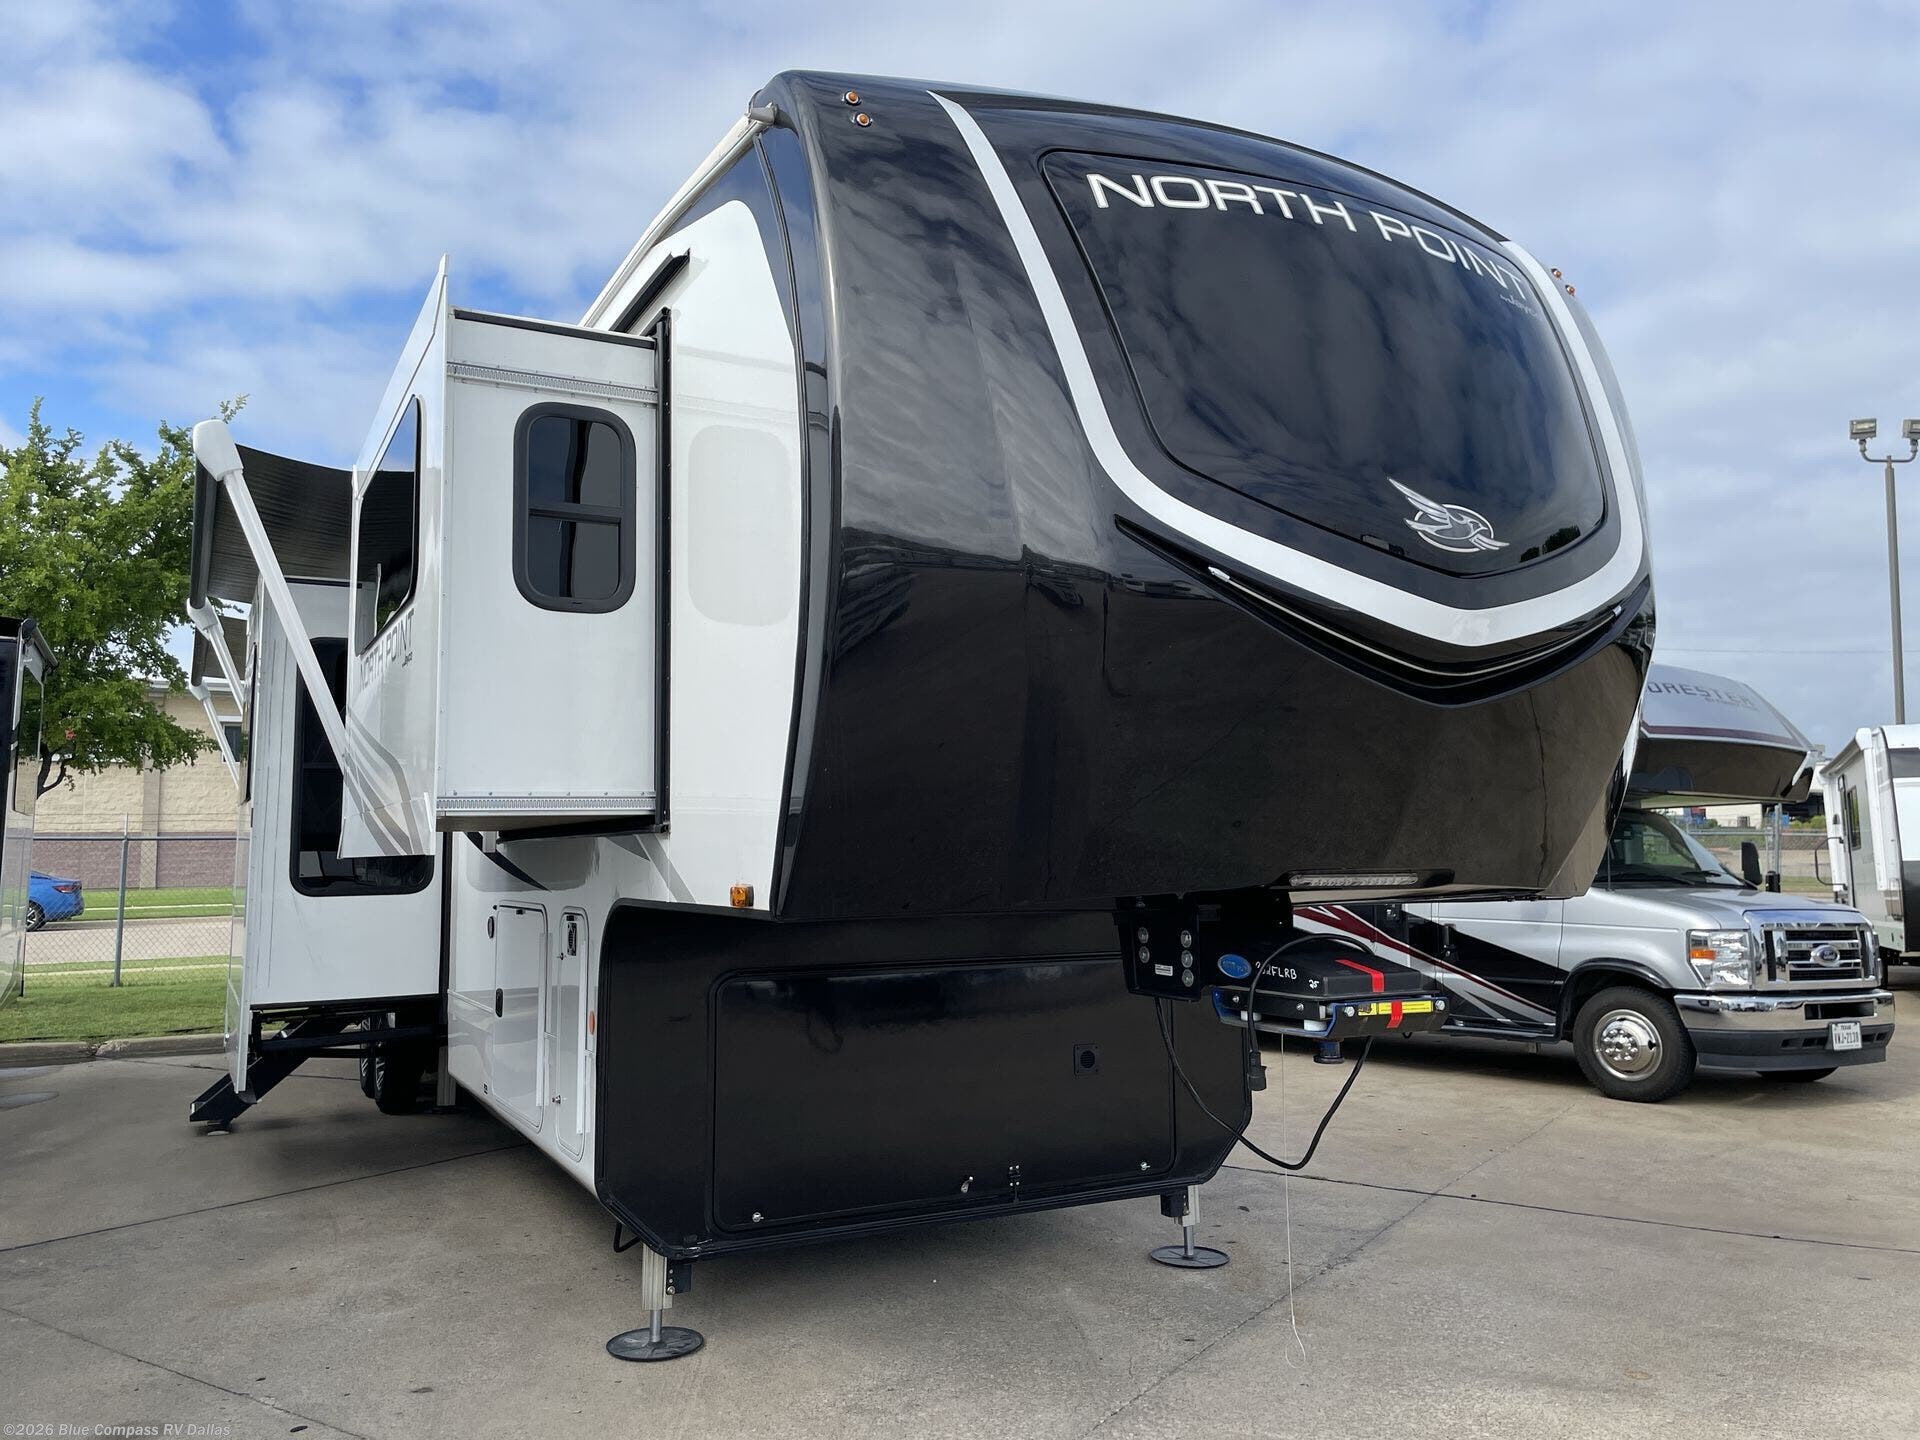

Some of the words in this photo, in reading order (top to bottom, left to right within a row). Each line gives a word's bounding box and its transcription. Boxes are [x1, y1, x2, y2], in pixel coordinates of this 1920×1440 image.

[1086, 173, 1358, 232] NORTH
[1368, 209, 1527, 300] POINT
[386, 608, 415, 668] POINT
[1647, 682, 1755, 708] ORESTER
